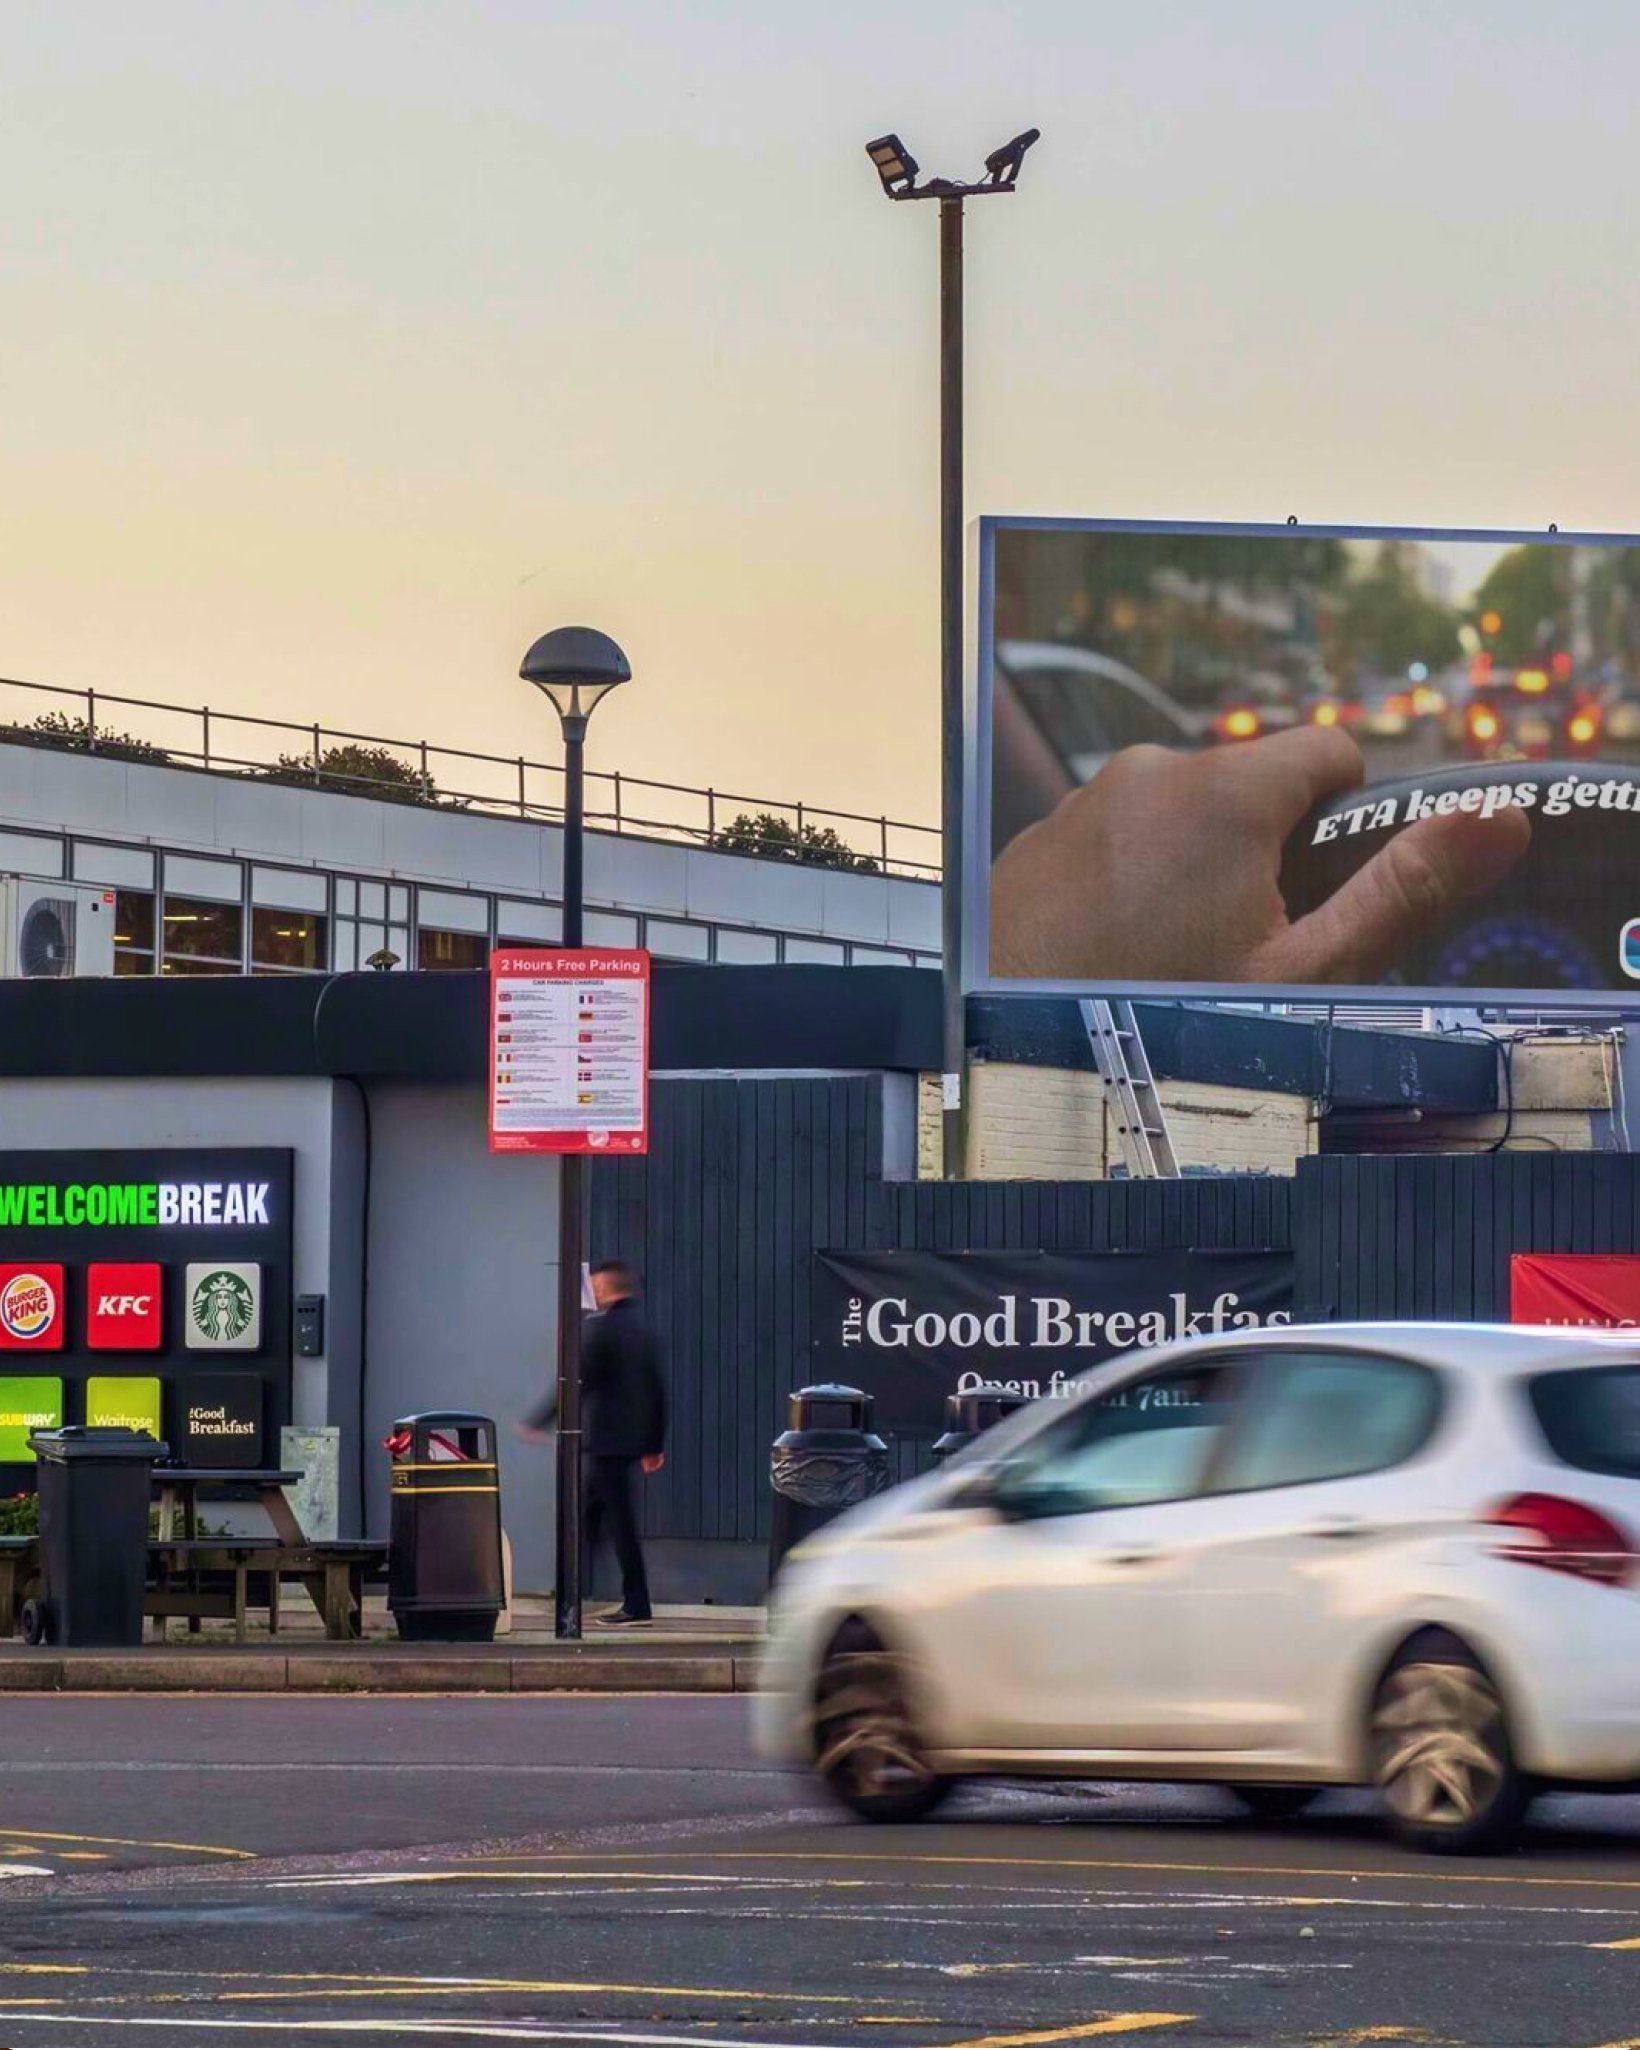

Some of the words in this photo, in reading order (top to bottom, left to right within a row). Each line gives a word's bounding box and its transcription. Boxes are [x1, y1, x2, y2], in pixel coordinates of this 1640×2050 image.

[1311, 798, 1398, 845] ETA
[1403, 781, 1539, 823] keeps
[502, 959, 510, 972] 2
[513, 959, 553, 972] Hours
[557, 959, 586, 972] Free
[590, 959, 640, 974] Parking
[8, 1287, 46, 1309] BURGER
[96, 1296, 151, 1315] KFC
[9, 1297, 48, 1324] KING
[867, 1295, 1021, 1348] Good
[1030, 1292, 1294, 1348] Breakfa
[842, 1297, 862, 1348] The
[0, 1413, 56, 1426] SUBWAY
[94, 1413, 154, 1428] Waitrose
[194, 1407, 225, 1420] Good
[190, 1420, 255, 1434] Breakfast
